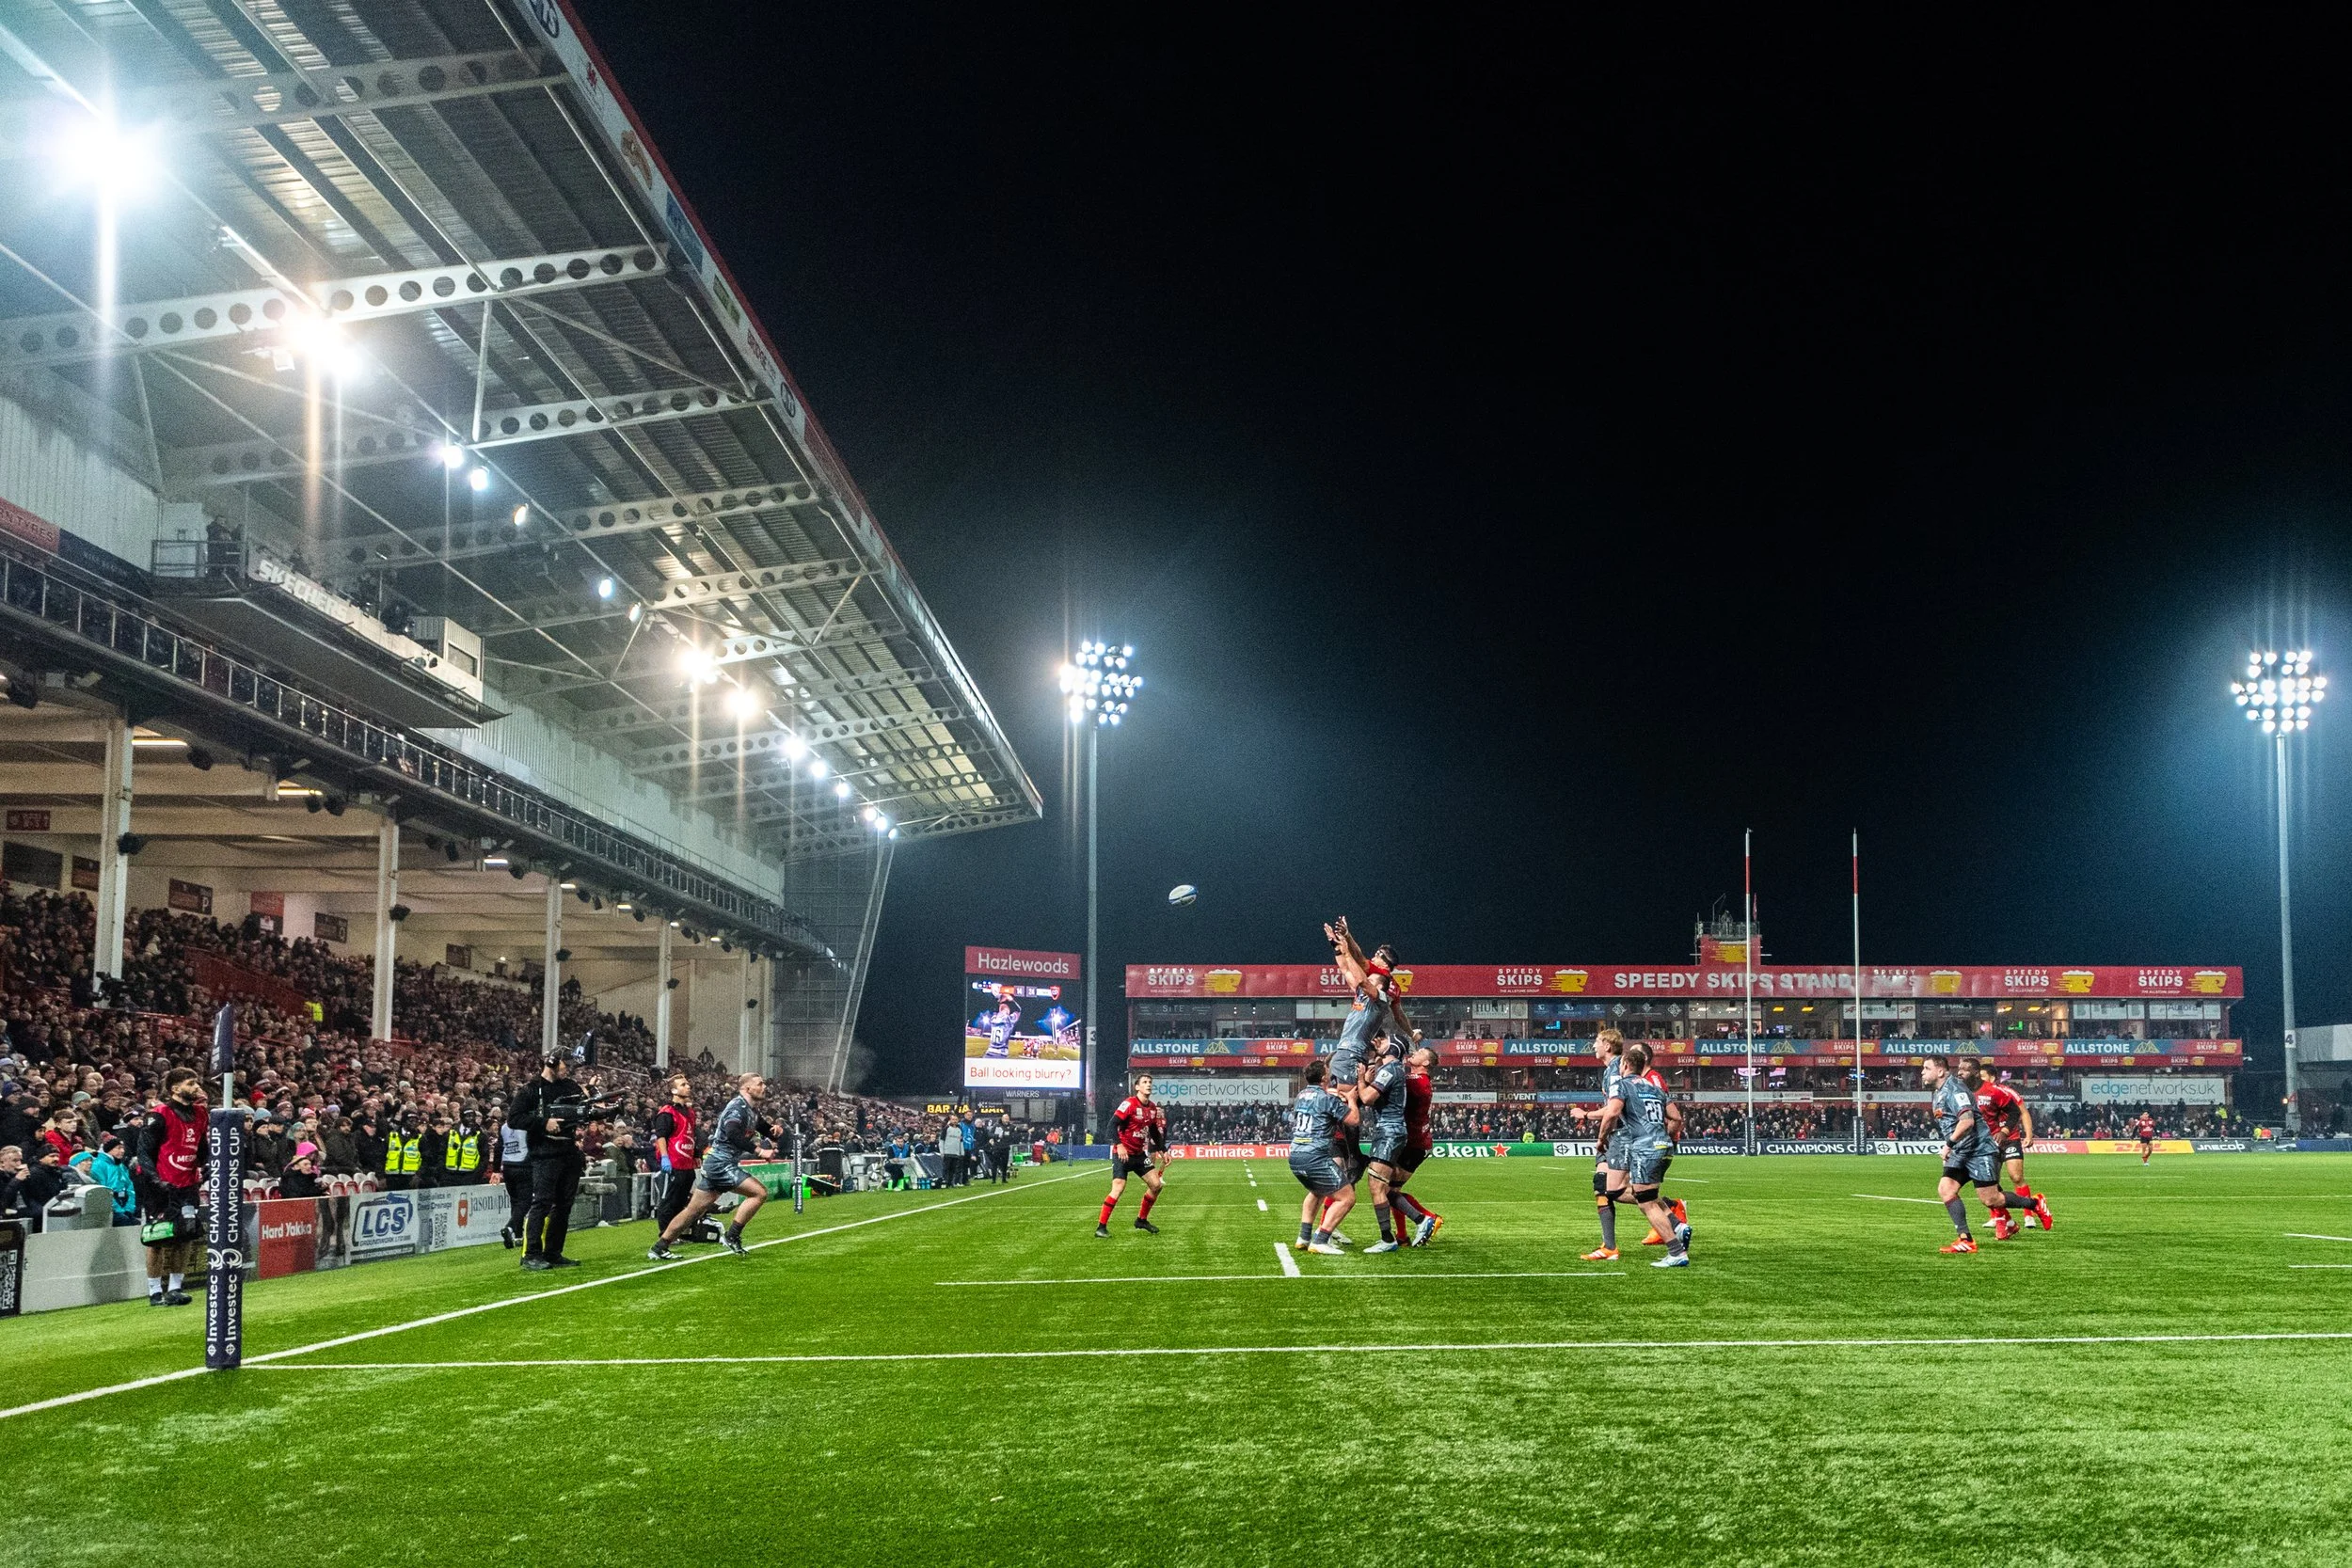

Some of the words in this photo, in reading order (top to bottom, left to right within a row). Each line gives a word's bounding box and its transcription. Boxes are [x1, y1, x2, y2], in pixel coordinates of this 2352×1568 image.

[977, 953, 1070, 974] Hazlewoods
[1147, 974, 1195, 986] SKIPS
[1319, 974, 1346, 986] SKI
[1497, 974, 1543, 986] SKIPS
[1614, 973, 1700, 989] SPEEDY
[1707, 973, 1773, 989] SKIPS
[1780, 973, 1852, 989] STAND
[2004, 975, 2050, 987] SKIPS
[2137, 975, 2184, 987] SKIPS
[2285, 1034, 2293, 1045] 4
[1132, 1043, 1200, 1053] ALLSTONE
[1509, 1043, 1576, 1053] ALLSTONE
[1700, 1043, 1766, 1053] ALLSTONE
[1885, 1043, 1951, 1053] ALLSTONE
[2065, 1043, 2130, 1053] ALLSTONE
[970, 1067, 989, 1078] Ball
[993, 1068, 1032, 1081] looking
[1035, 1069, 1072, 1081] blurry?
[2090, 1080, 2216, 1098] edgenetworks.uk
[1498, 1092, 1537, 1101] FLOVENT
[211, 1127, 221, 1156] CUP
[229, 1127, 240, 1156] CUP
[1196, 1147, 1255, 1158] Emirates
[1432, 1143, 1489, 1158] eken
[1677, 1144, 1738, 1154] Investec
[1767, 1144, 1845, 1154] CHAMPIONS
[1847, 1144, 1873, 1154] CP
[209, 1159, 221, 1243] CHAMPIONS
[228, 1158, 239, 1243] CHAMPIONS
[469, 1192, 494, 1216] jason
[362, 1206, 405, 1239] LCS
[262, 1223, 284, 1240] Hard
[285, 1221, 312, 1237] Yakka
[207, 1275, 217, 1342] Investec
[225, 1274, 237, 1342] Investec
